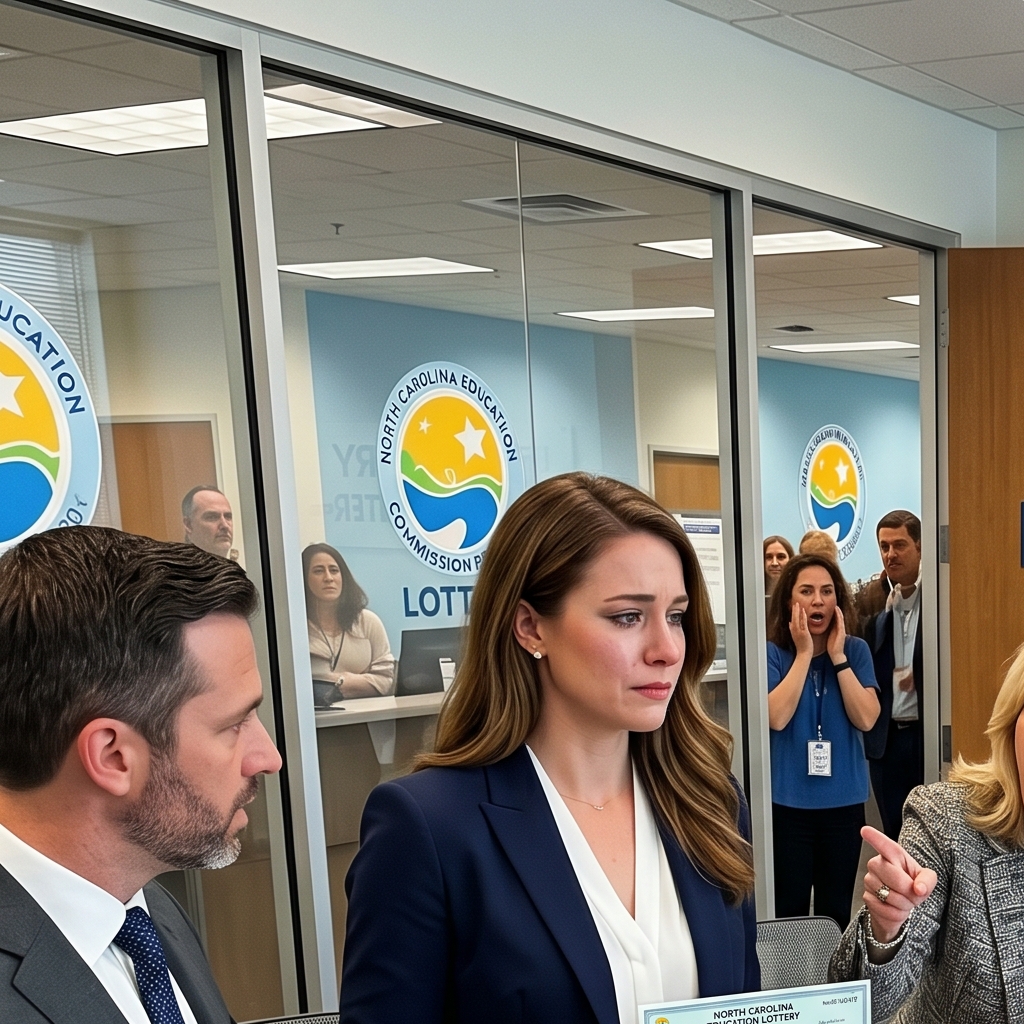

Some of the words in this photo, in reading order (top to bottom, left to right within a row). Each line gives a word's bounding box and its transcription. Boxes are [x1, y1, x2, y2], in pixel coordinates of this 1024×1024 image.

[381, 402, 401, 464] NORTH
[398, 368, 457, 404] CAROLINA
[389, 502, 472, 572] COMMISSION
[713, 1008, 746, 1020] NORTH
[748, 1003, 793, 1015] CAROLINA
[761, 1012, 801, 1024] LOTTERY
